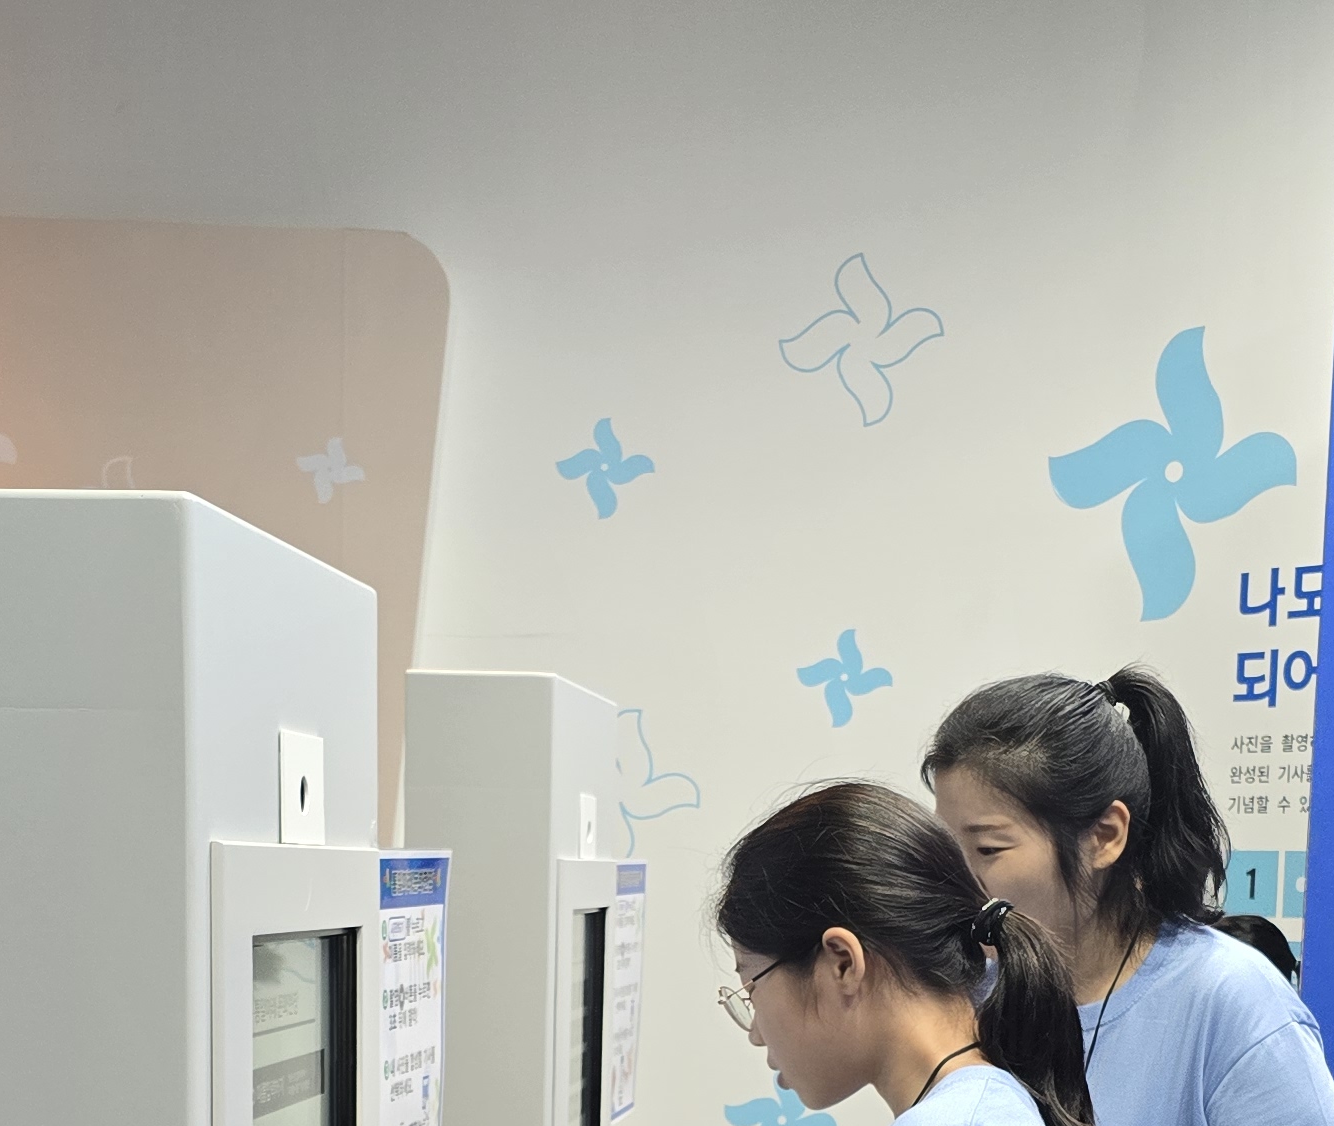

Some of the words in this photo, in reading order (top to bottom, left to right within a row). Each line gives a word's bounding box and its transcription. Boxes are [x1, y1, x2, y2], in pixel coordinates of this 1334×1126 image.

[1231, 735, 1273, 754] 사진을
[1281, 733, 1314, 753] 촬영
[1229, 765, 1270, 784] 완성된
[1228, 796, 1269, 814] 기념할
[1277, 796, 1291, 814] 수
[1246, 868, 1256, 900] 1
